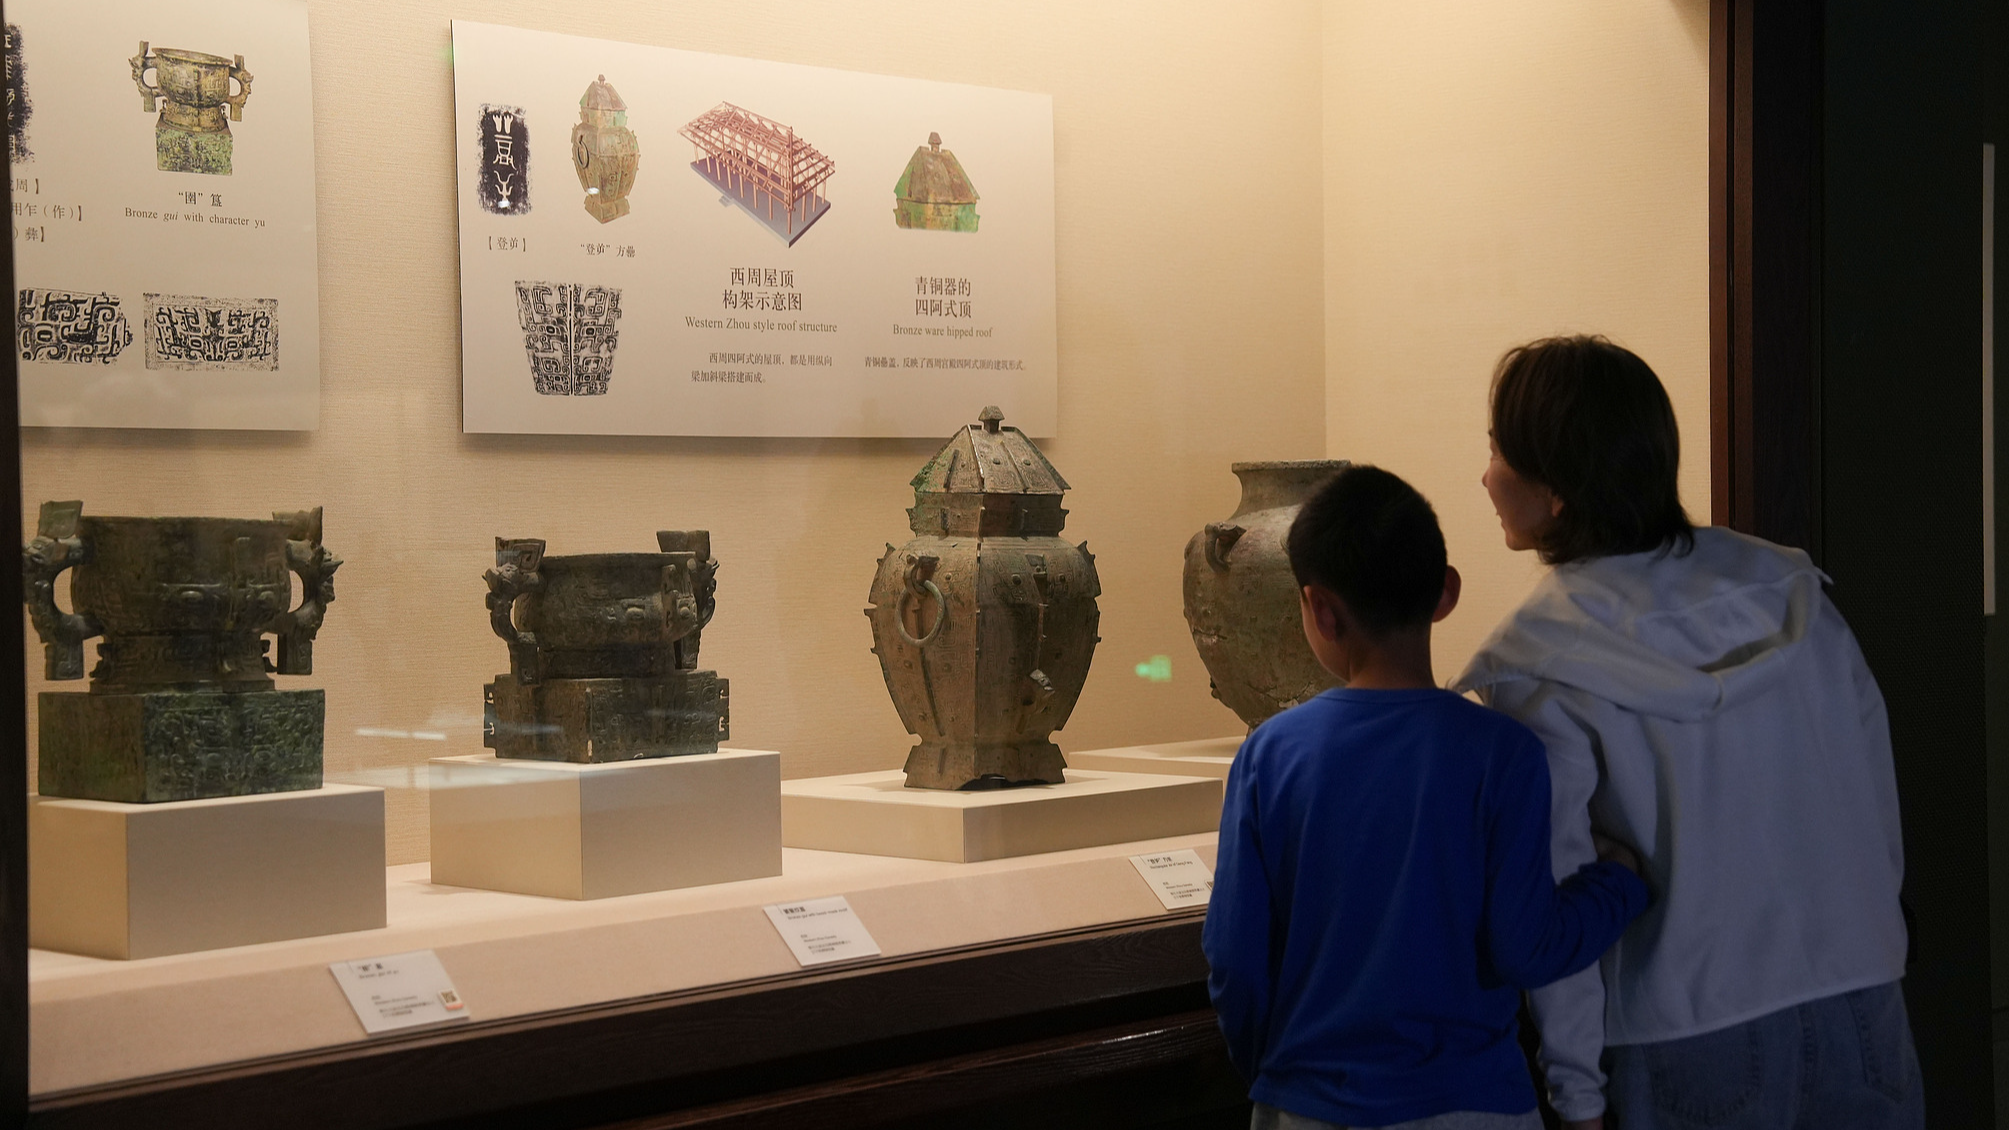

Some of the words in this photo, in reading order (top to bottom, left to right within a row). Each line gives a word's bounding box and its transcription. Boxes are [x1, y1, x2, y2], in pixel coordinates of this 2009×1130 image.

[125, 207, 158, 220] Bronze
[163, 211, 178, 222] gui
[184, 212, 204, 223] with
[209, 214, 250, 226] character
[254, 218, 266, 228] yu
[730, 267, 794, 289] 西周屋顶
[915, 275, 971, 297] 青铜器的
[723, 289, 802, 312] 构架示意图
[915, 298, 972, 319] 四阿式顶
[685, 316, 723, 329] Western
[726, 317, 750, 330] Zhou
[753, 319, 775, 333] style
[777, 320, 798, 332] roof
[799, 322, 838, 333] structure
[893, 324, 923, 336] Bronze
[925, 328, 944, 336] ware
[947, 326, 973, 339] hipped
[976, 327, 993, 338] roof
